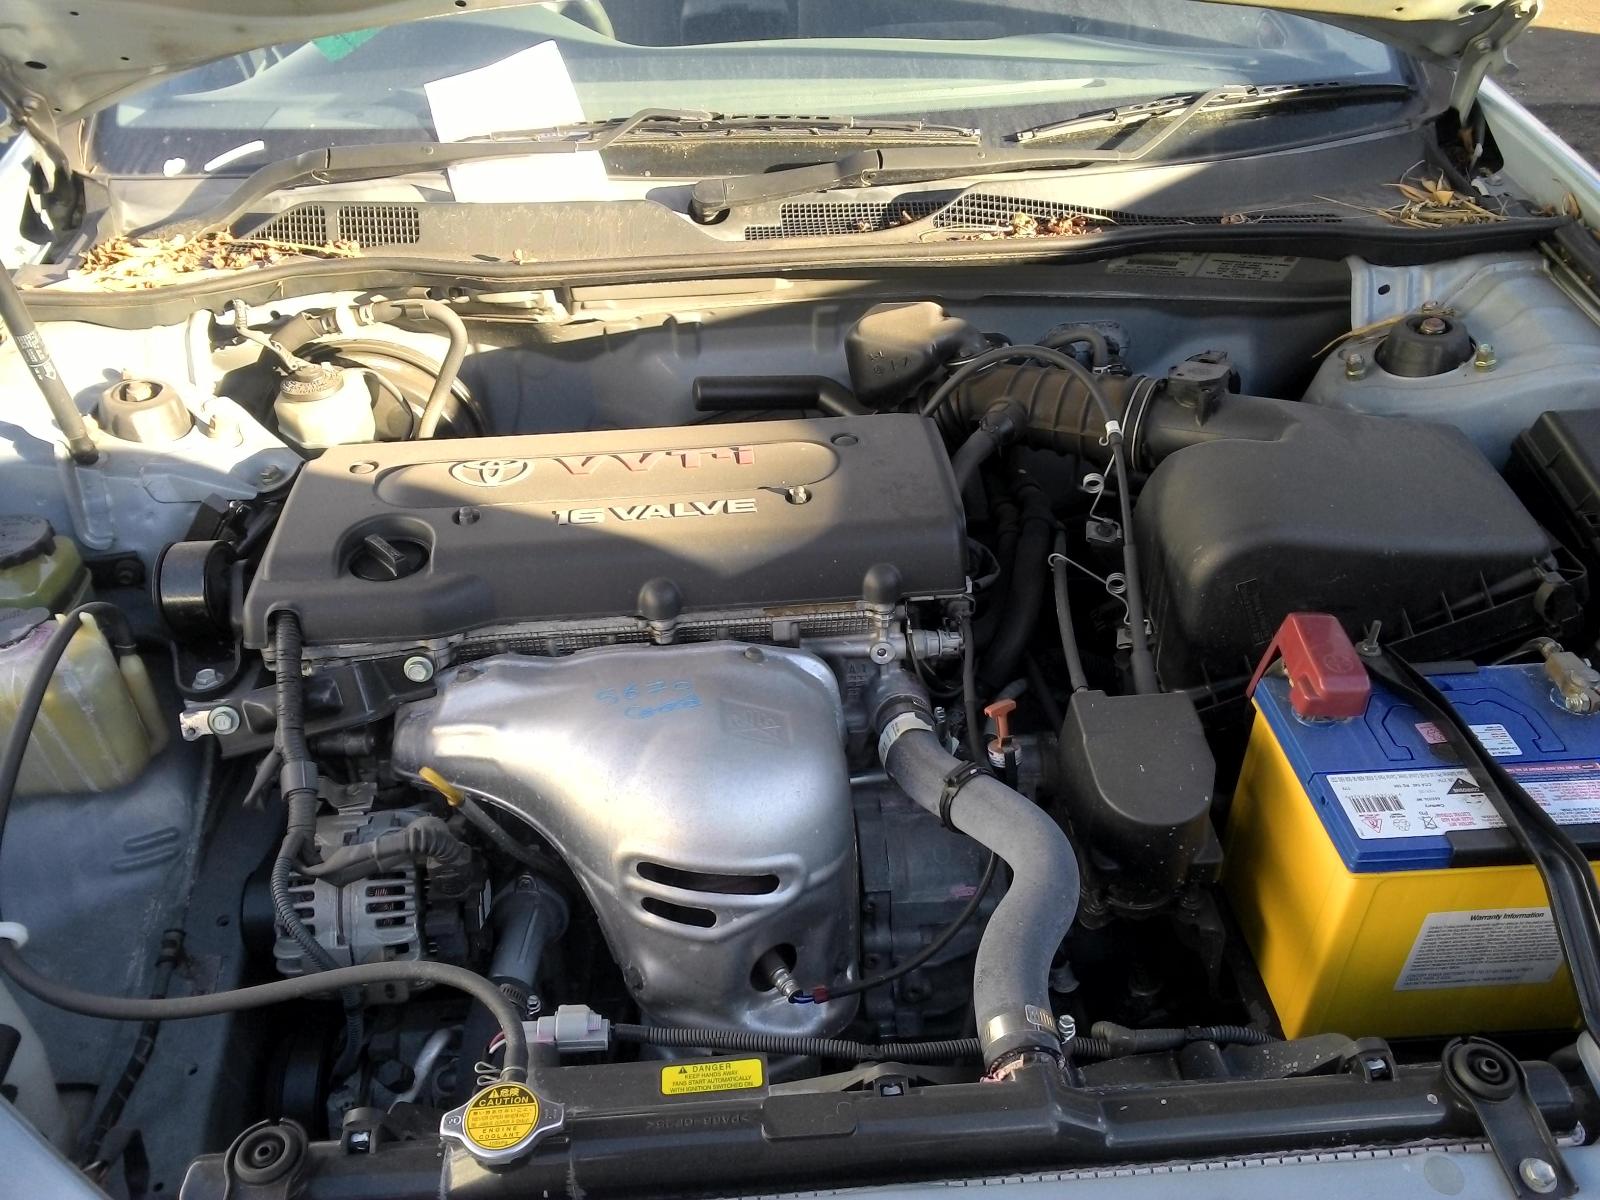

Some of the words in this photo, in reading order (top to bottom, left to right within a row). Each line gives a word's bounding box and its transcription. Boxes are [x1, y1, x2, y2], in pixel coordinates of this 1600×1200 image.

[551, 508, 605, 526] 16
[608, 498, 758, 521] VALVE
[1470, 913, 1502, 922] Warranty
[1503, 911, 1544, 920] Information
[692, 1062, 732, 1073] DANGER
[707, 1075, 752, 1084] AUTOMATICALLY
[712, 1082, 743, 1090] SWITCHED
[478, 1096, 529, 1107] CAUTION
[482, 1125, 518, 1134] ENGINE
[478, 1131, 520, 1140] COOLANT
